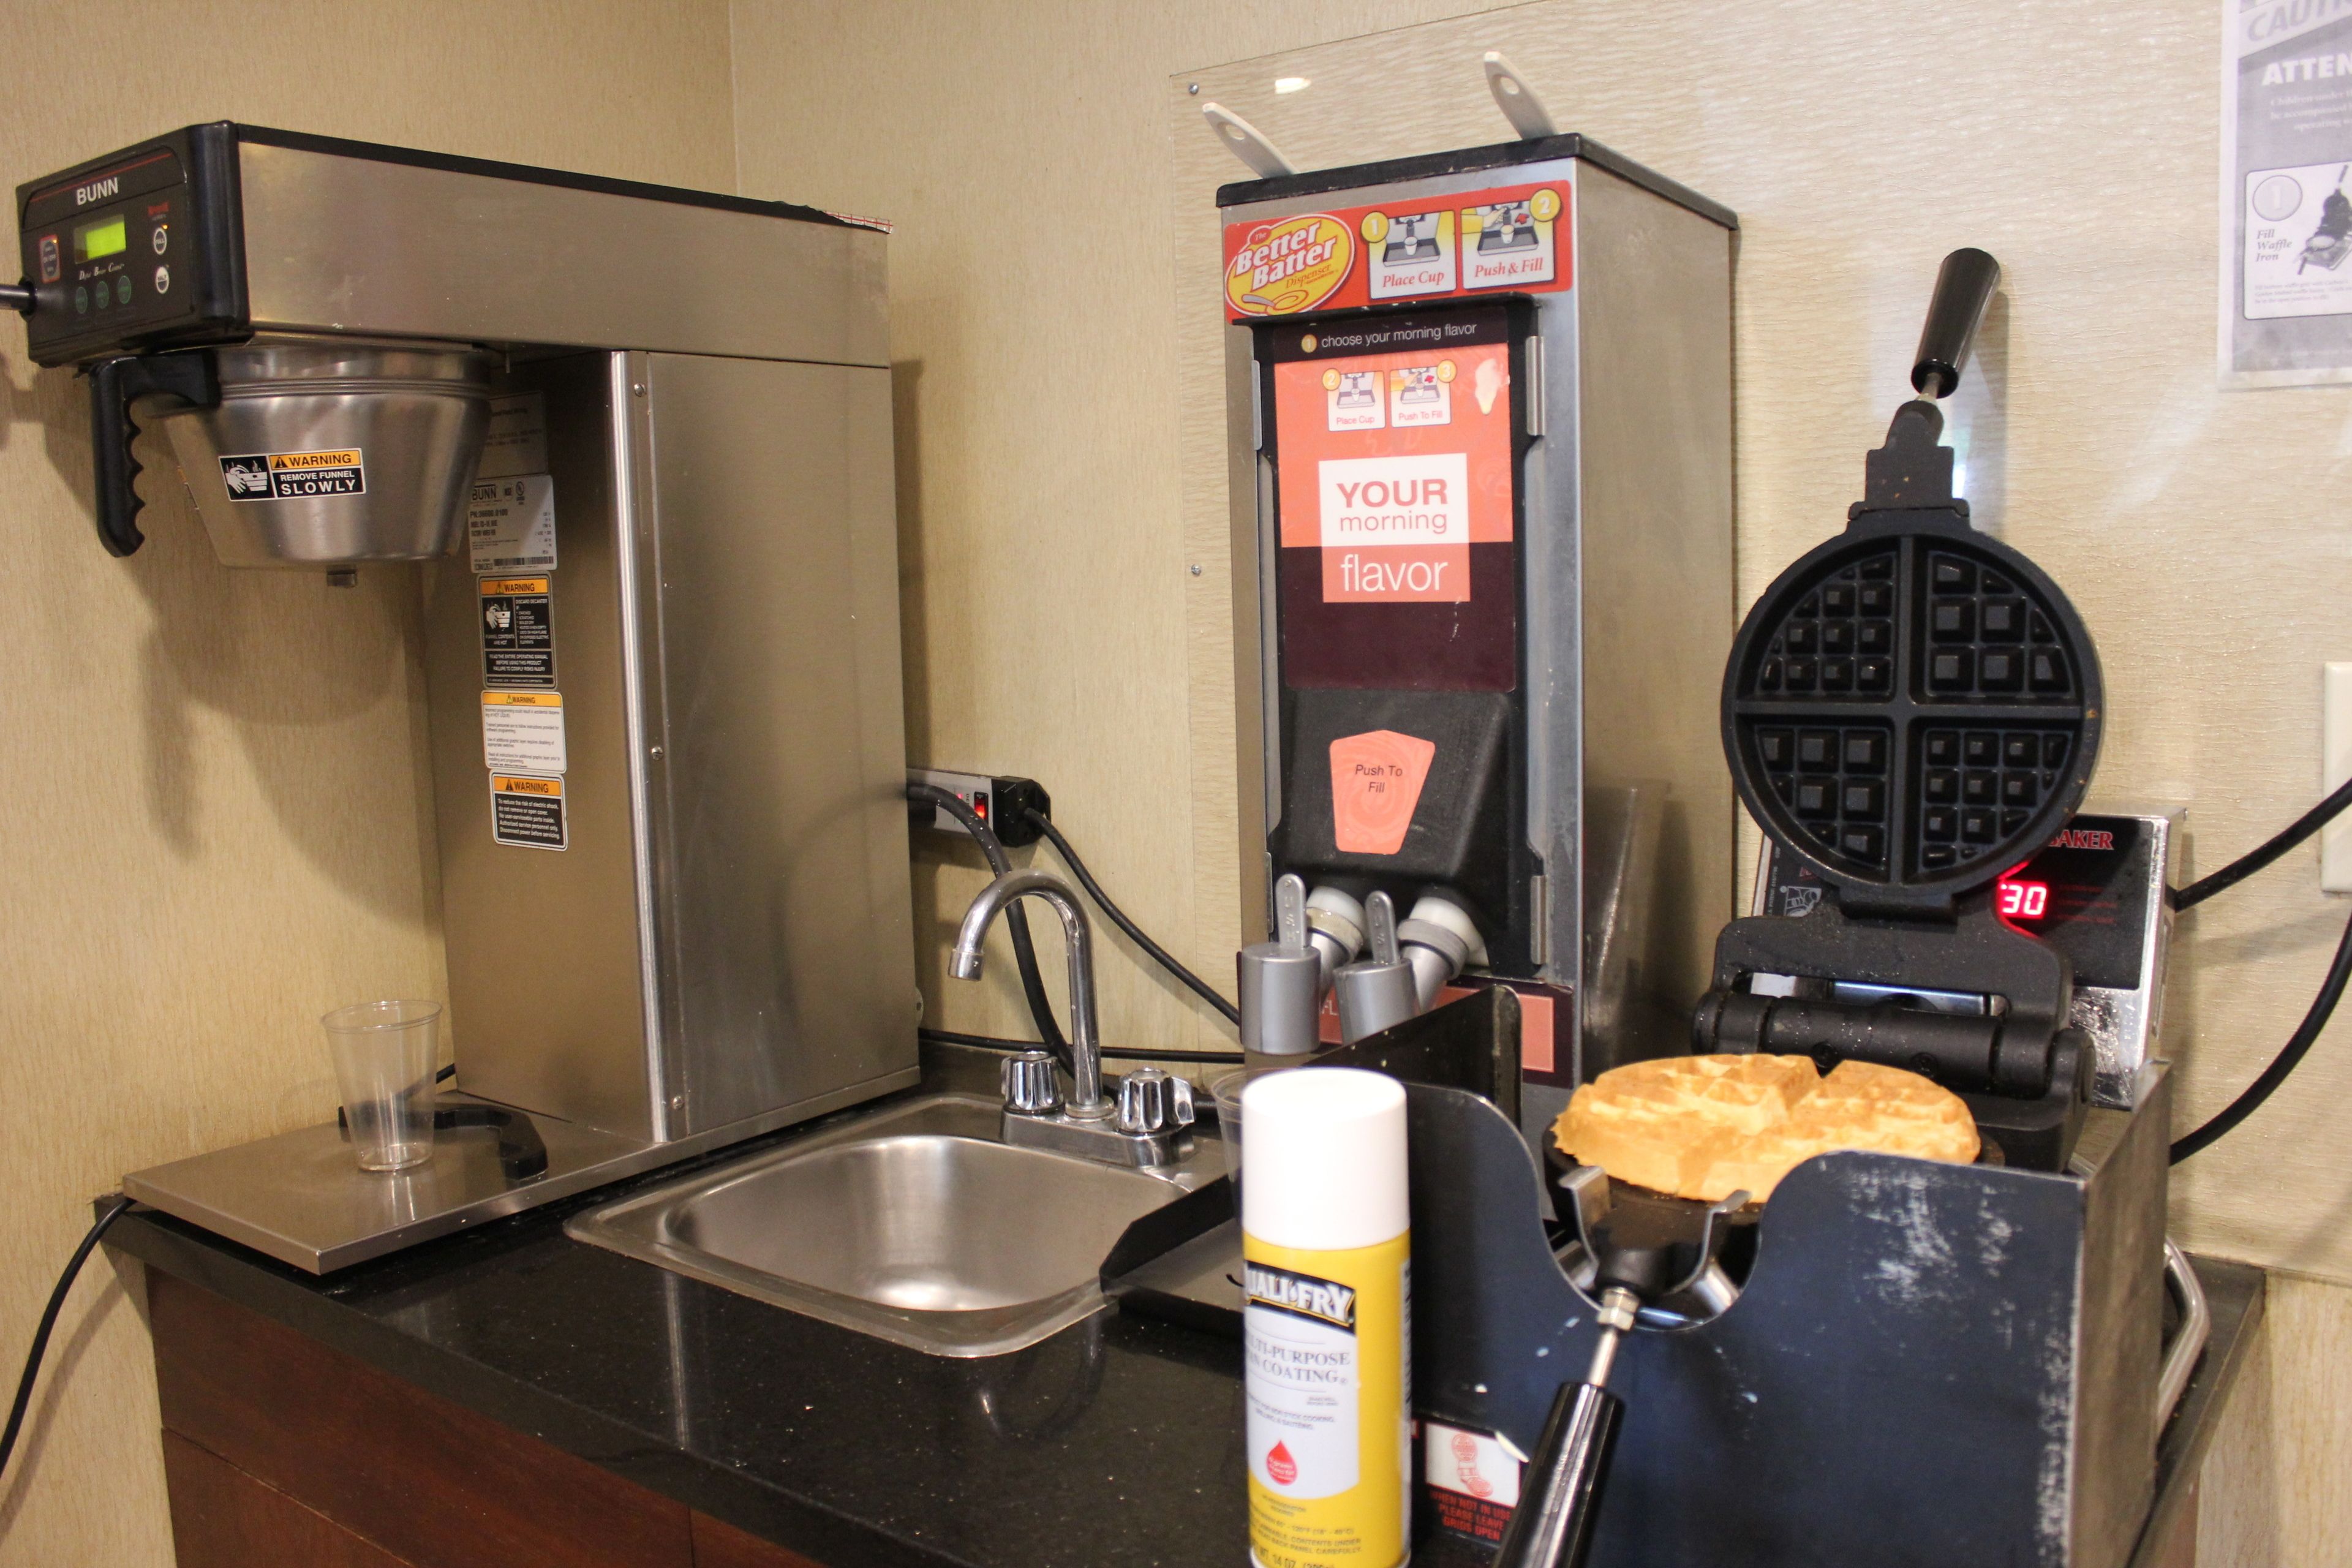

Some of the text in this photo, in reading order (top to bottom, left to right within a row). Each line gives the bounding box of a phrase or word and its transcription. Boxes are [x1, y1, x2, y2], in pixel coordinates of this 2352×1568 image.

[76, 177, 119, 205] BUNN
[1539, 197, 1550, 213] 2
[1370, 219, 1378, 235] 1
[2256, 229, 2275, 239] Fill
[1234, 220, 1321, 277] Better
[2257, 239, 2293, 251] Waffle
[1251, 235, 1337, 292] Batter
[2256, 253, 2279, 262] Iron
[1475, 258, 1544, 277] Push & Fill
[1286, 265, 1331, 288] Dispenser
[1382, 271, 1444, 287] Place Cup
[1321, 323, 1477, 348] choose your morning flavor
[1443, 365, 1451, 377] 3
[1329, 374, 1335, 385] 2
[1359, 416, 1374, 425] Cup
[1398, 412, 1418, 421] Push
[1431, 410, 1443, 419] Fill
[289, 454, 352, 467] WARNING
[280, 470, 355, 481] REMOVE FUNNEL
[281, 480, 356, 495] SLOWLY
[1336, 478, 1448, 508] YOUR
[1340, 510, 1447, 535] morning
[1340, 553, 1448, 592] flavor
[504, 583, 535, 592] WARNING
[1355, 764, 1403, 777] Push To
[514, 781, 548, 793] WARNING
[1368, 782, 1385, 793] Fill
[2048, 829, 2114, 850] AKER
[2002, 884, 2047, 915] 30
[1263, 1359, 1338, 1384] COATING
